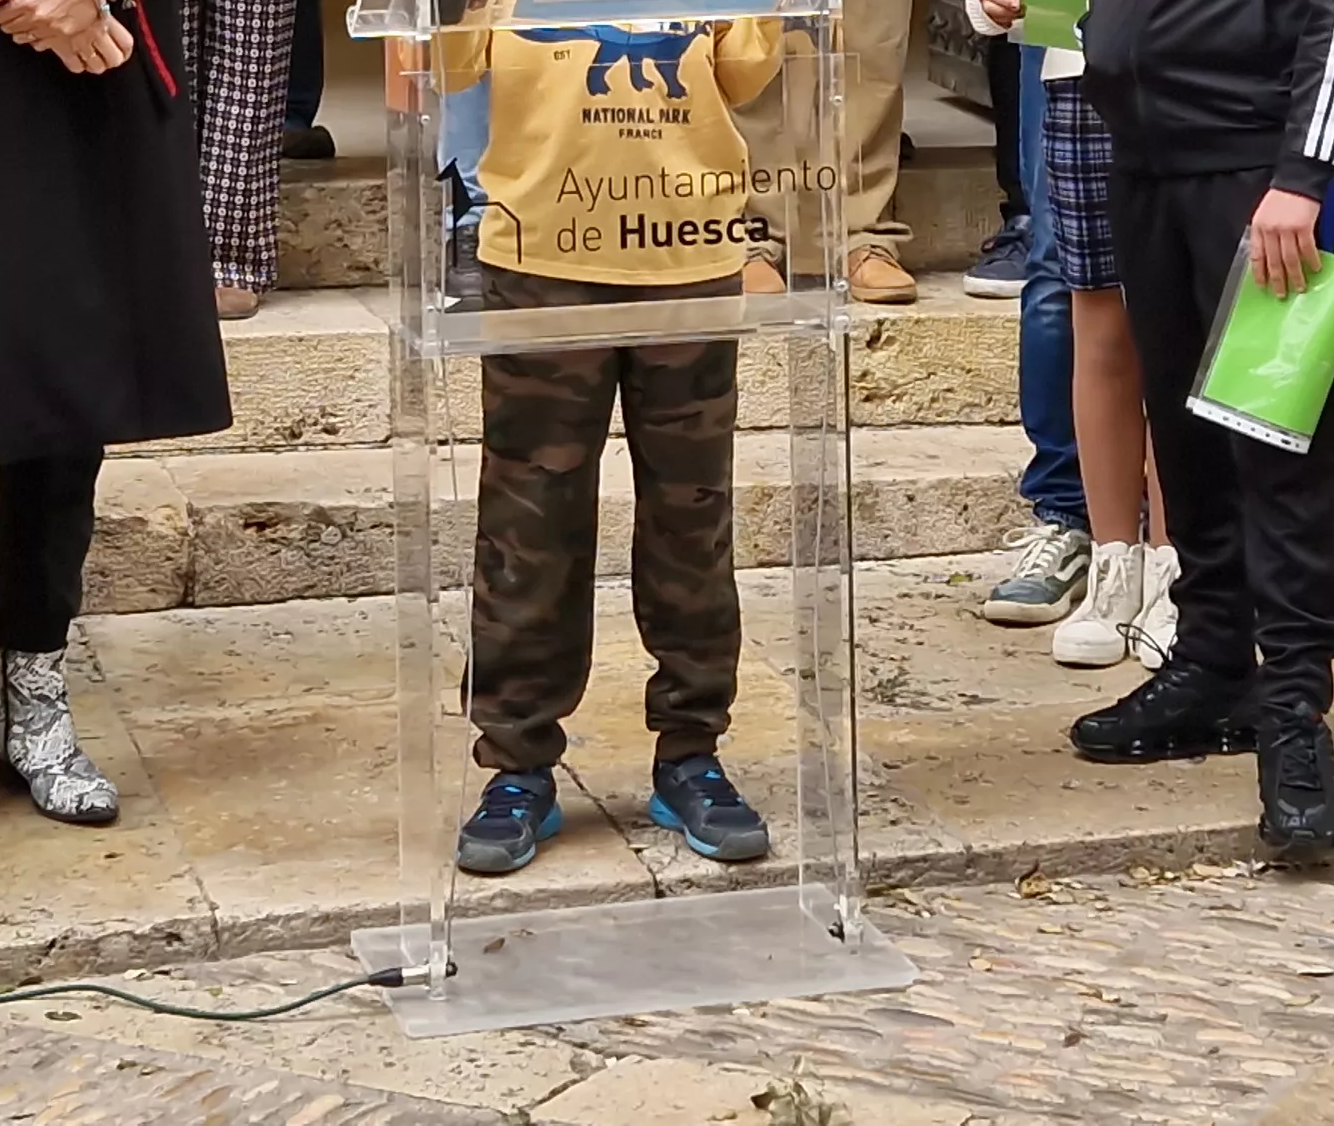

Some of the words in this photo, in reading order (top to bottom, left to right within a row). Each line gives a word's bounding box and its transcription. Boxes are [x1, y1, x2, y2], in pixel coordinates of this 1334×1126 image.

[582, 107, 655, 124] NATIONAL
[659, 107, 691, 124] PARK
[556, 159, 837, 212] Ayuntamiento
[556, 217, 602, 253] de
[619, 213, 769, 250] Huesca
